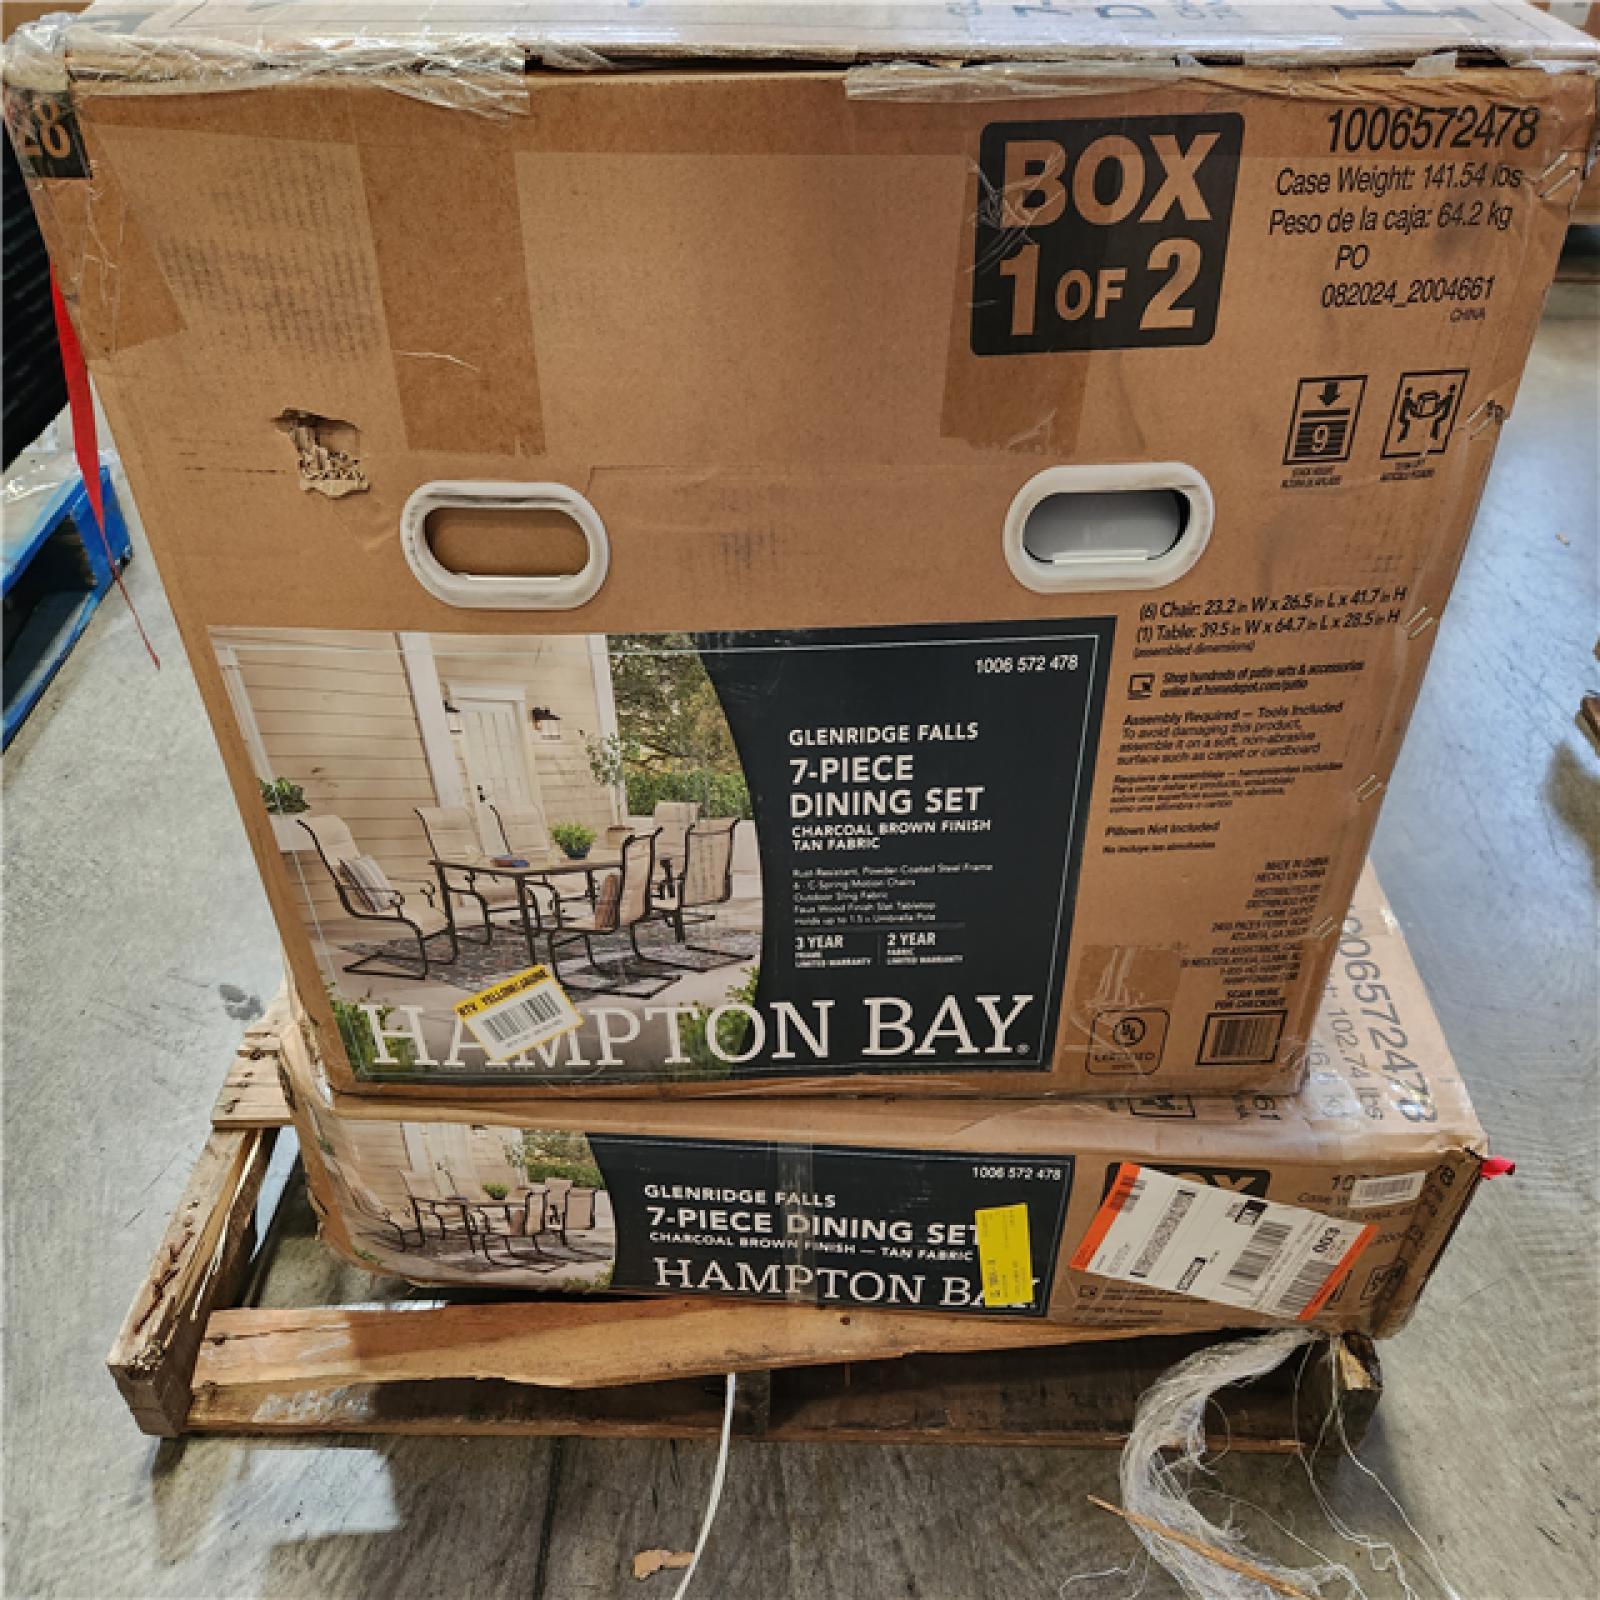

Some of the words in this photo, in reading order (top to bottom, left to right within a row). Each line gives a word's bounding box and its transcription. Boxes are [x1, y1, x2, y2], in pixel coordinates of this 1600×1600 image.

[1327, 104, 1541, 153] 1006572478
[1002, 132, 1221, 227] BOX
[1276, 167, 1331, 195] Case
[1337, 164, 1413, 198] Weight:
[1424, 161, 1489, 190] 141.54
[1491, 161, 1522, 187] lbs
[1269, 209, 1321, 236] Peso
[1327, 207, 1354, 233] de
[1359, 205, 1377, 231] la
[1384, 204, 1433, 235] caja:
[1436, 200, 1483, 228] 64.2
[1487, 200, 1513, 231] kg
[1335, 244, 1370, 270] PO
[999, 244, 1040, 336] 1
[1055, 267, 1128, 321] OF
[1139, 237, 1201, 330] 2
[1320, 275, 1496, 309] 082024_2004661
[1449, 306, 1486, 322] CHINA
[1311, 424, 1330, 453] 9
[1160, 600, 1200, 618] Chair:
[1204, 597, 1235, 616] 23.2
[1252, 596, 1268, 612] W
[1270, 600, 1278, 611] x
[1281, 593, 1313, 610] 26.5
[1327, 592, 1336, 608] L
[1350, 587, 1381, 606] 41.7
[1393, 585, 1408, 600] H
[1136, 625, 1153, 644] (1)
[1157, 622, 1195, 640] Table:
[1200, 621, 1231, 638] 39.5
[1245, 619, 1262, 635] W
[1263, 622, 1272, 633] x
[1275, 616, 1306, 633] 64.7
[1319, 614, 1329, 630] L
[1343, 609, 1375, 628] 28.5
[1387, 608, 1401, 623] H
[975, 656, 1014, 674] 1006
[1016, 655, 1046, 673] 572
[1049, 654, 1079, 671] 478
[1123, 713, 1183, 726] Assembly
[1184, 709, 1240, 723] Required
[1257, 706, 1289, 718] Tools
[1292, 702, 1345, 716] Included
[789, 724, 911, 746] GLENRIDGE
[917, 721, 979, 742] FALLS
[1120, 740, 1173, 752] assemble
[1185, 739, 1201, 749] on
[1122, 727, 1135, 739] To
[1137, 727, 1171, 738] avoid
[1172, 724, 1228, 737] damaging
[1230, 722, 1251, 733] this
[1207, 748, 1246, 762] carpet
[1261, 743, 1321, 758] cardboard
[789, 754, 915, 786] 7-PIECE
[789, 789, 913, 819] DINING
[924, 784, 986, 814] SET
[791, 823, 875, 839] CHARCOAL
[879, 820, 936, 837] BROWN
[941, 818, 992, 833] FINISH
[792, 838, 824, 852] TAN
[826, 836, 881, 851] FABRIC
[794, 935, 804, 951] 3
[806, 933, 844, 949] YEAR
[886, 931, 897, 946] 2
[899, 931, 936, 946] YEAR
[1340, 905, 1439, 1122] 006572478
[1328, 1006, 1371, 1078] 102.74
[1357, 1086, 1383, 1120] lbs
[972, 1166, 1006, 1179] 1006
[1007, 1167, 1034, 1180] 572
[1036, 1167, 1061, 1181] 478
[644, 1184, 767, 1205] GLENRIDGE
[774, 1189, 836, 1209] FALLS
[647, 1206, 773, 1234] 7-PIECE
[786, 1213, 913, 1243] DINING
[649, 1231, 735, 1247] CHARCOAL
[739, 1236, 799, 1250] BROWN
[804, 1239, 856, 1254] FINISH
[880, 1246, 914, 1259] TAN
[916, 1248, 974, 1262] FABRIC
[653, 1256, 926, 1304] HAMPTON
